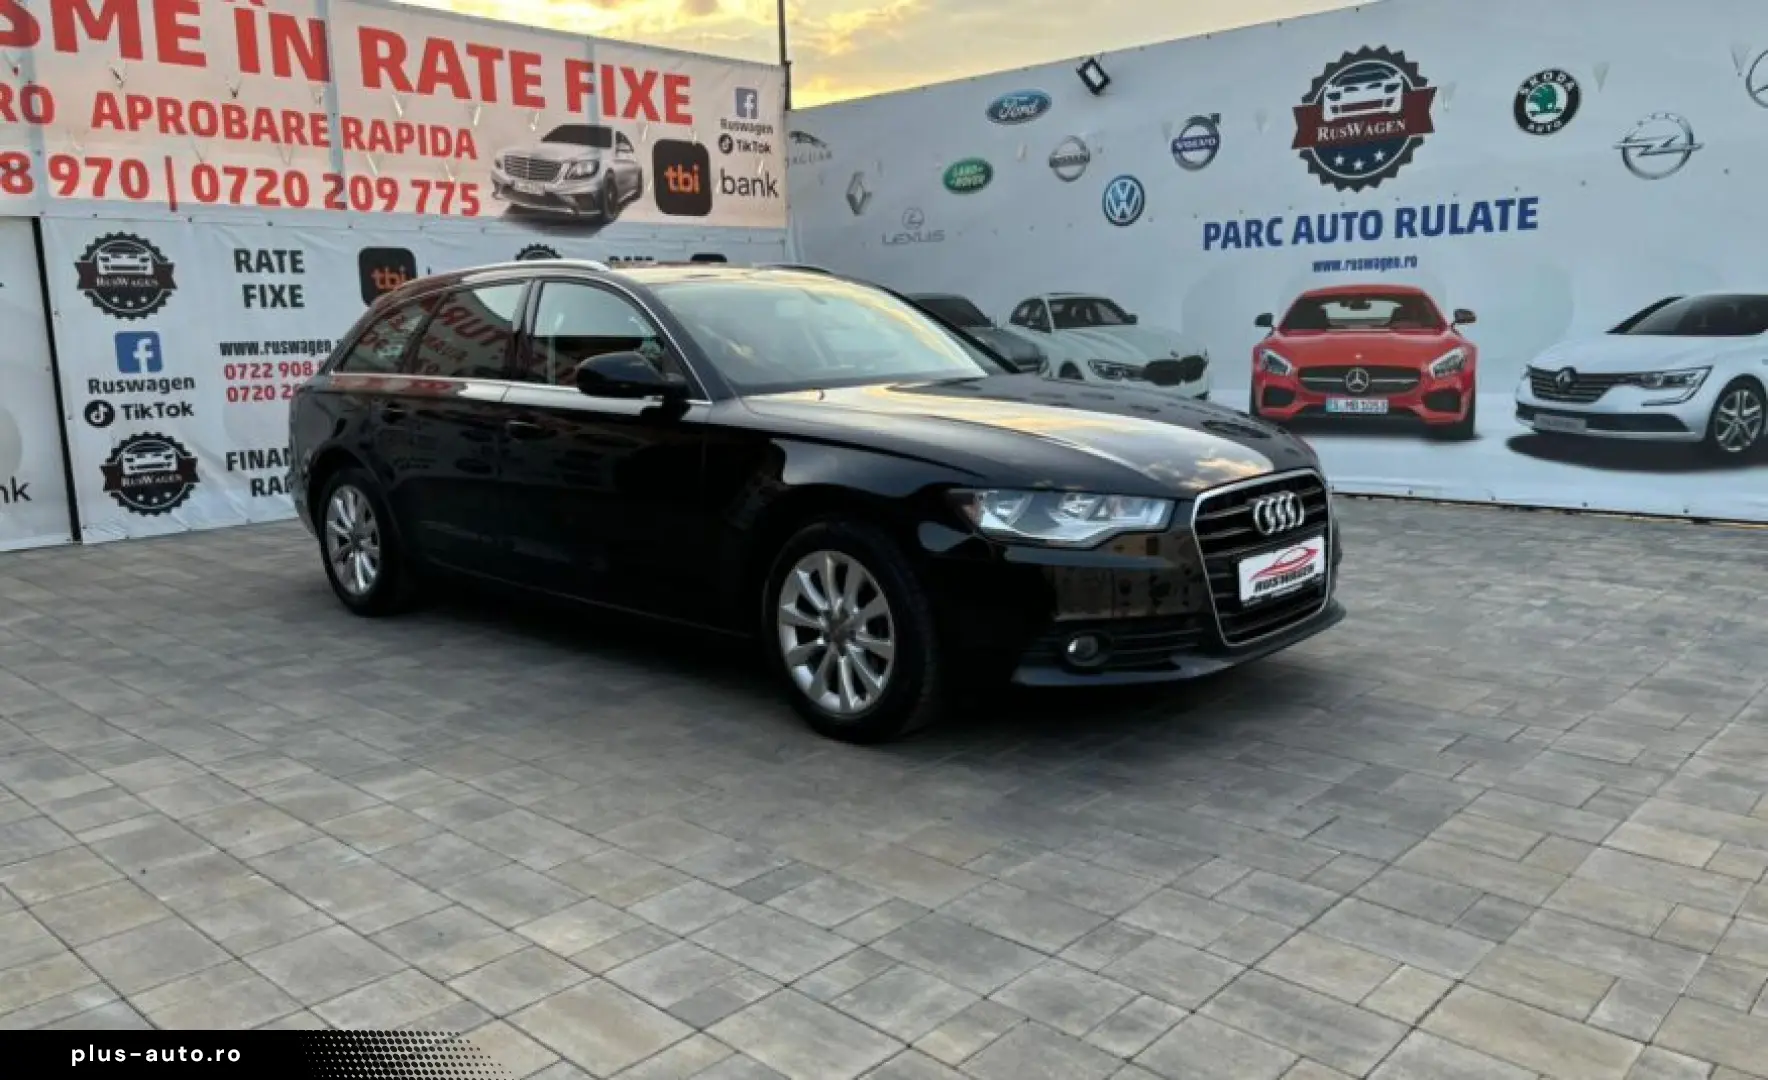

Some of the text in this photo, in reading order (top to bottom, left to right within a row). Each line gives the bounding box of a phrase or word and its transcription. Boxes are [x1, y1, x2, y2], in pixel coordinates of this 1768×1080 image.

[358, 26, 545, 109] RATE
[564, 59, 693, 126] FIXE
[92, 92, 331, 147] APROBARE
[342, 116, 477, 160] RAPIDA
[736, 139, 771, 153] TikTok
[48, 154, 149, 199] 970
[191, 163, 309, 209] 0720
[323, 174, 399, 212] 209
[411, 179, 480, 217] 775
[664, 163, 779, 198] tbi bank
[1204, 196, 1539, 250] PARC AUTO RULATE
[881, 229, 946, 246] LEXUS
[234, 248, 305, 273] RATE
[242, 284, 305, 309] FIXE
[225, 362, 273, 380] 0722
[279, 361, 313, 378] 908
[88, 376, 195, 395] Ruswagen
[228, 384, 275, 402] 0720
[120, 401, 195, 421] TikTok
